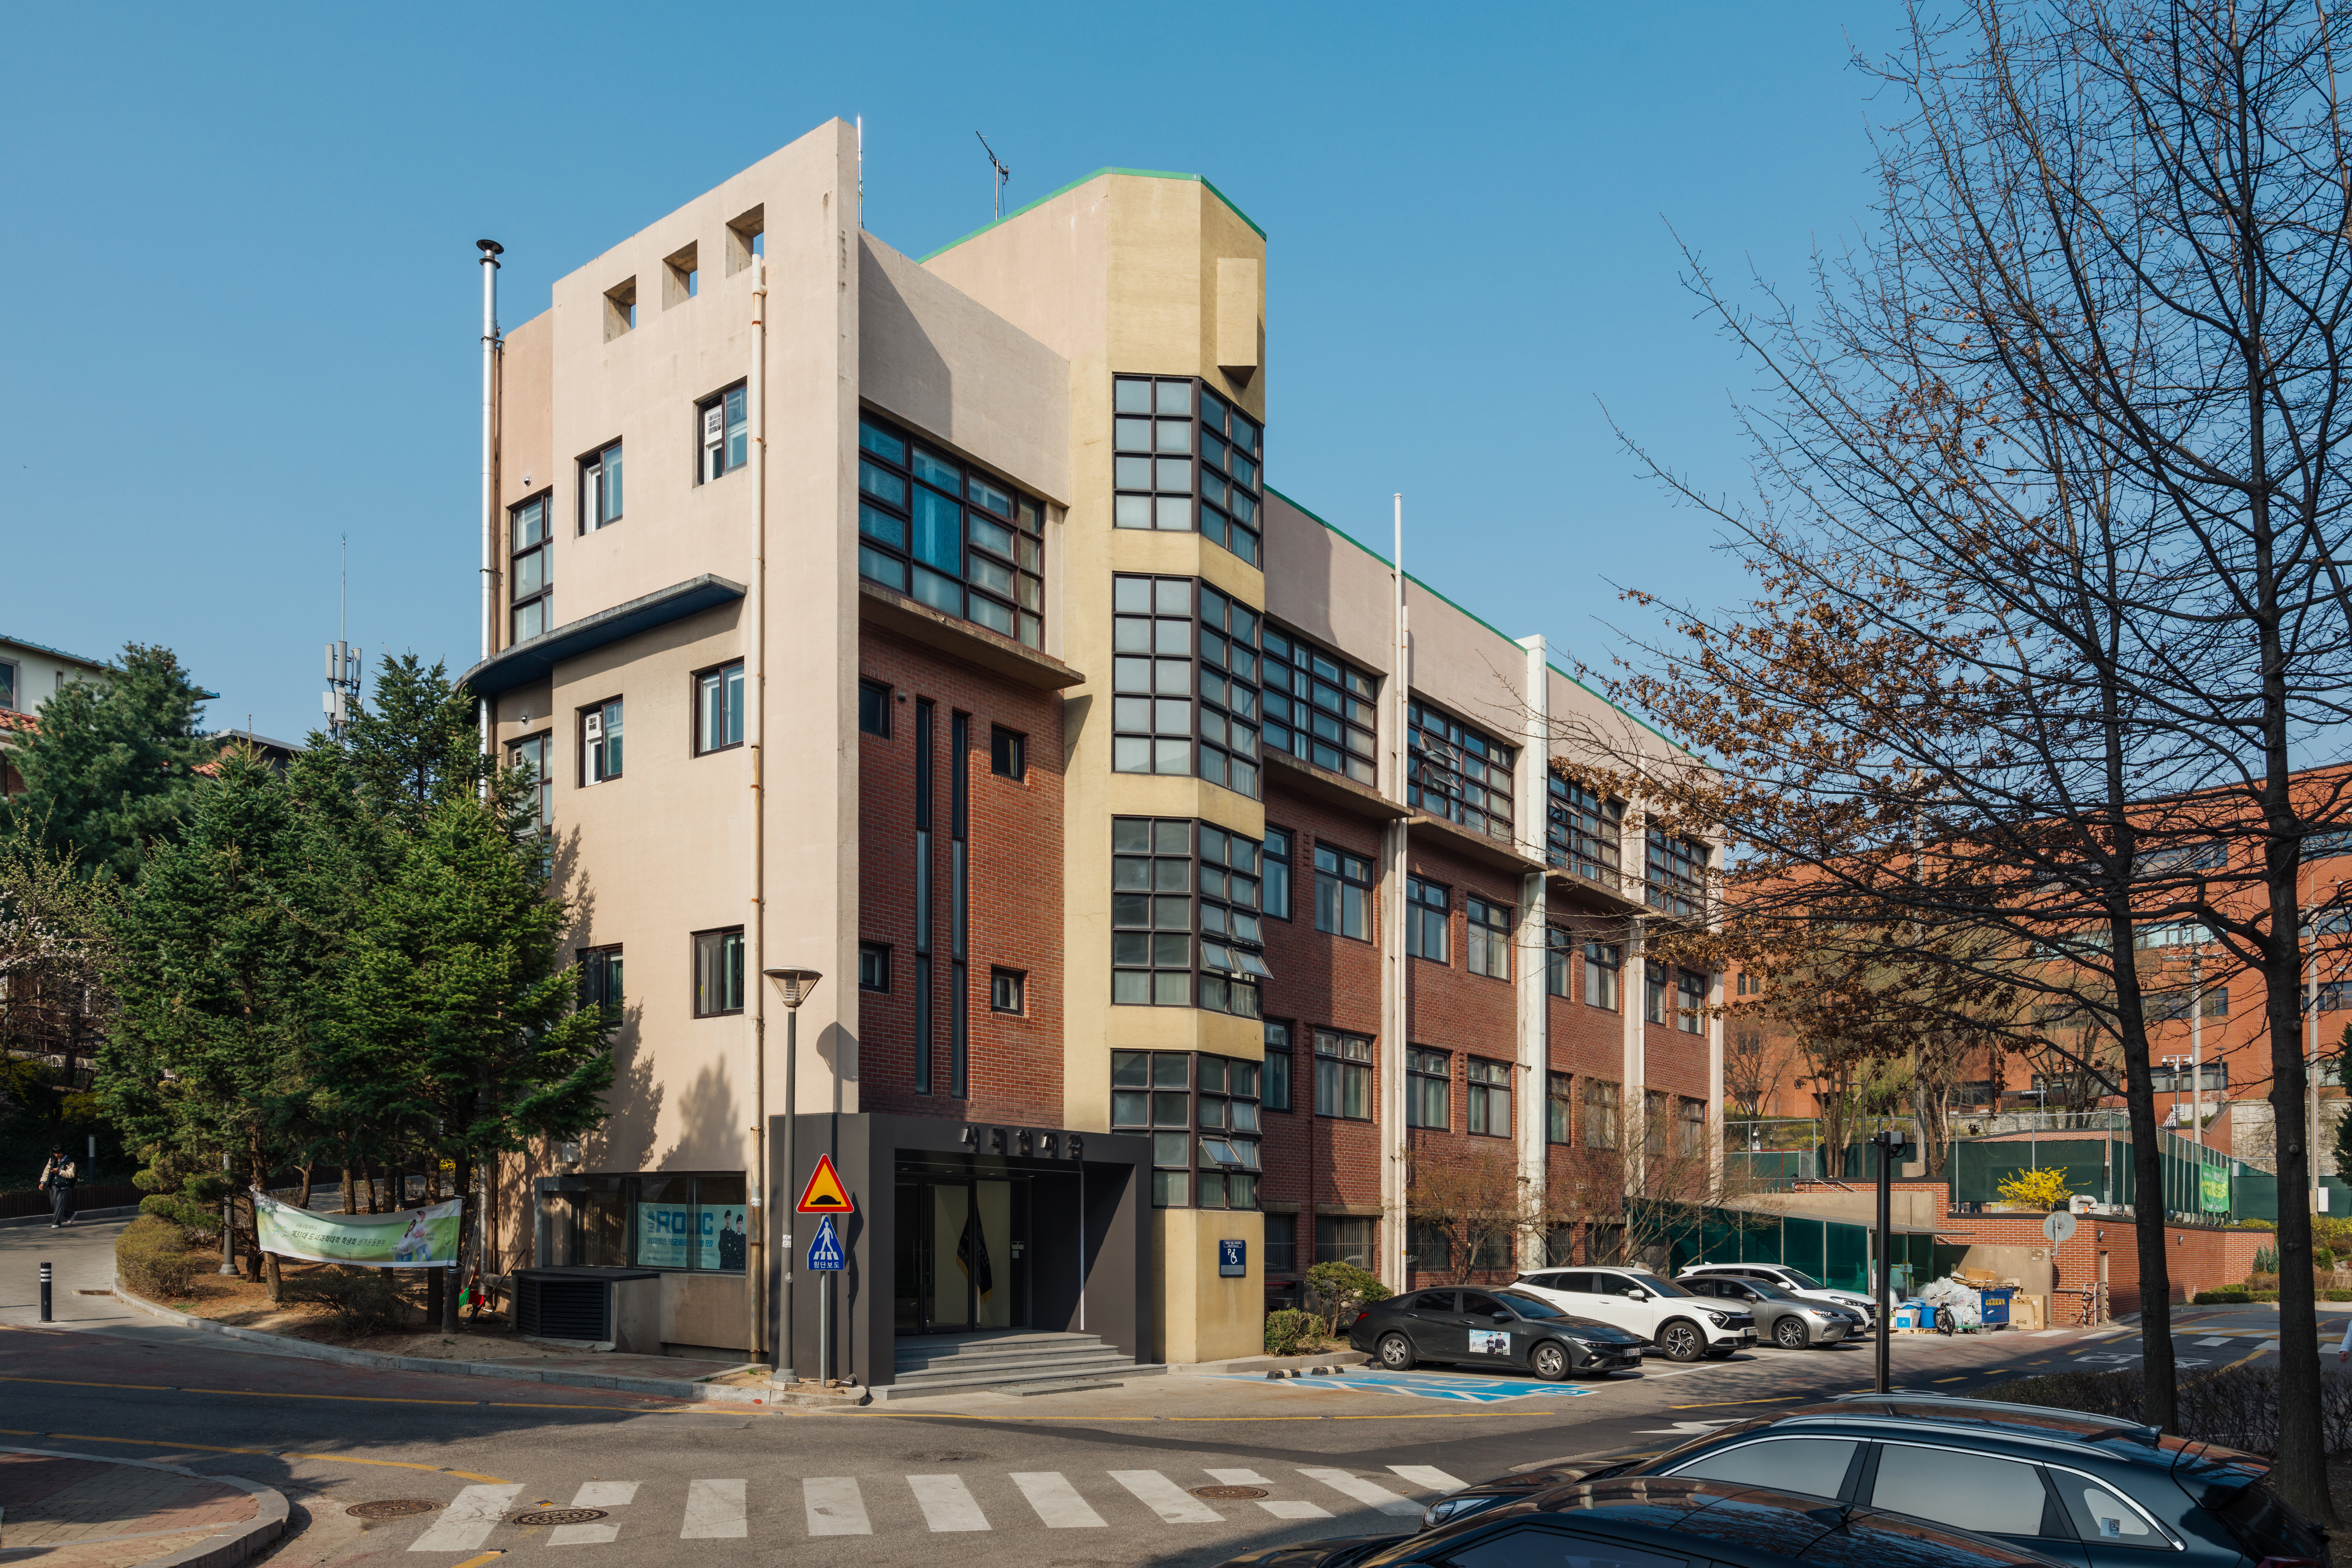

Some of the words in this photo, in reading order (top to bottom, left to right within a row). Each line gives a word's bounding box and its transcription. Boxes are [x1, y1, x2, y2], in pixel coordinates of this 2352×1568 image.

[656, 1211, 714, 1235] ROC
[292, 1230, 309, 1239] 제31대
[308, 1233, 341, 1244] 도시과학대학
[341, 1237, 357, 1245] 학생회
[357, 1238, 386, 1246] 선거운동본부
[647, 1237, 667, 1245] 2026년
